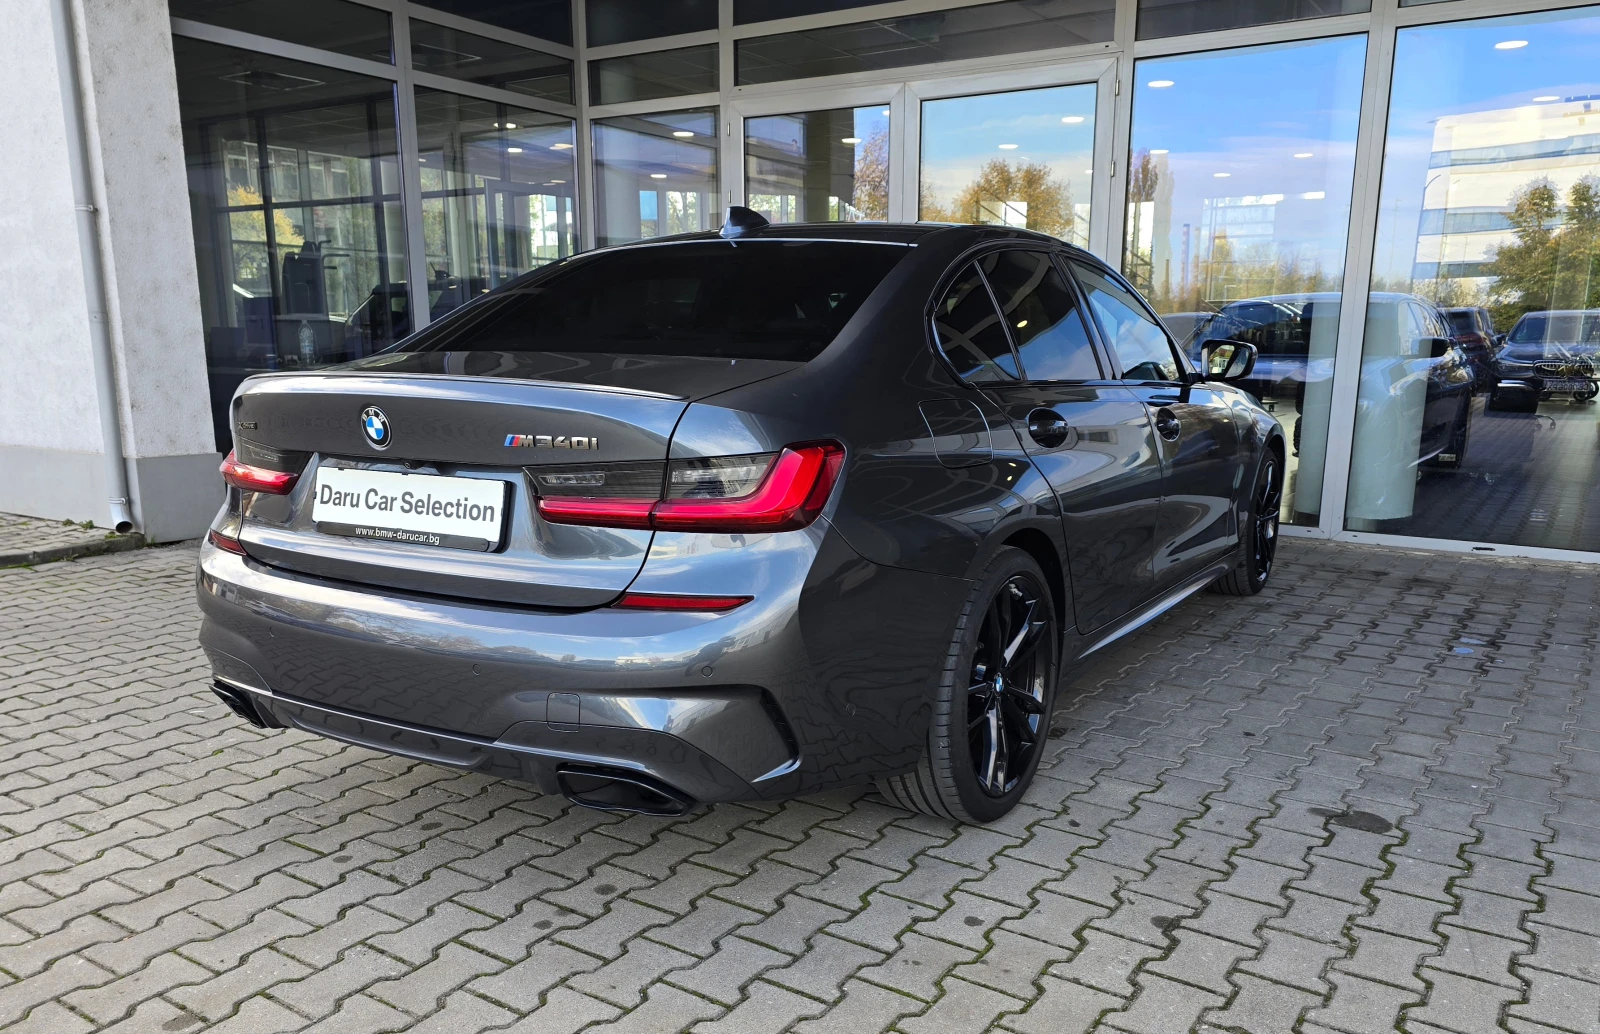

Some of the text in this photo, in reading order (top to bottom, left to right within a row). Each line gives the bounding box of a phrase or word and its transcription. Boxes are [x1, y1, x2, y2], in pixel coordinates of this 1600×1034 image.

[517, 434, 598, 450] M340i
[319, 483, 496, 523] Daru Car Selection
[355, 527, 441, 546] www.bmw-darucar.bg
